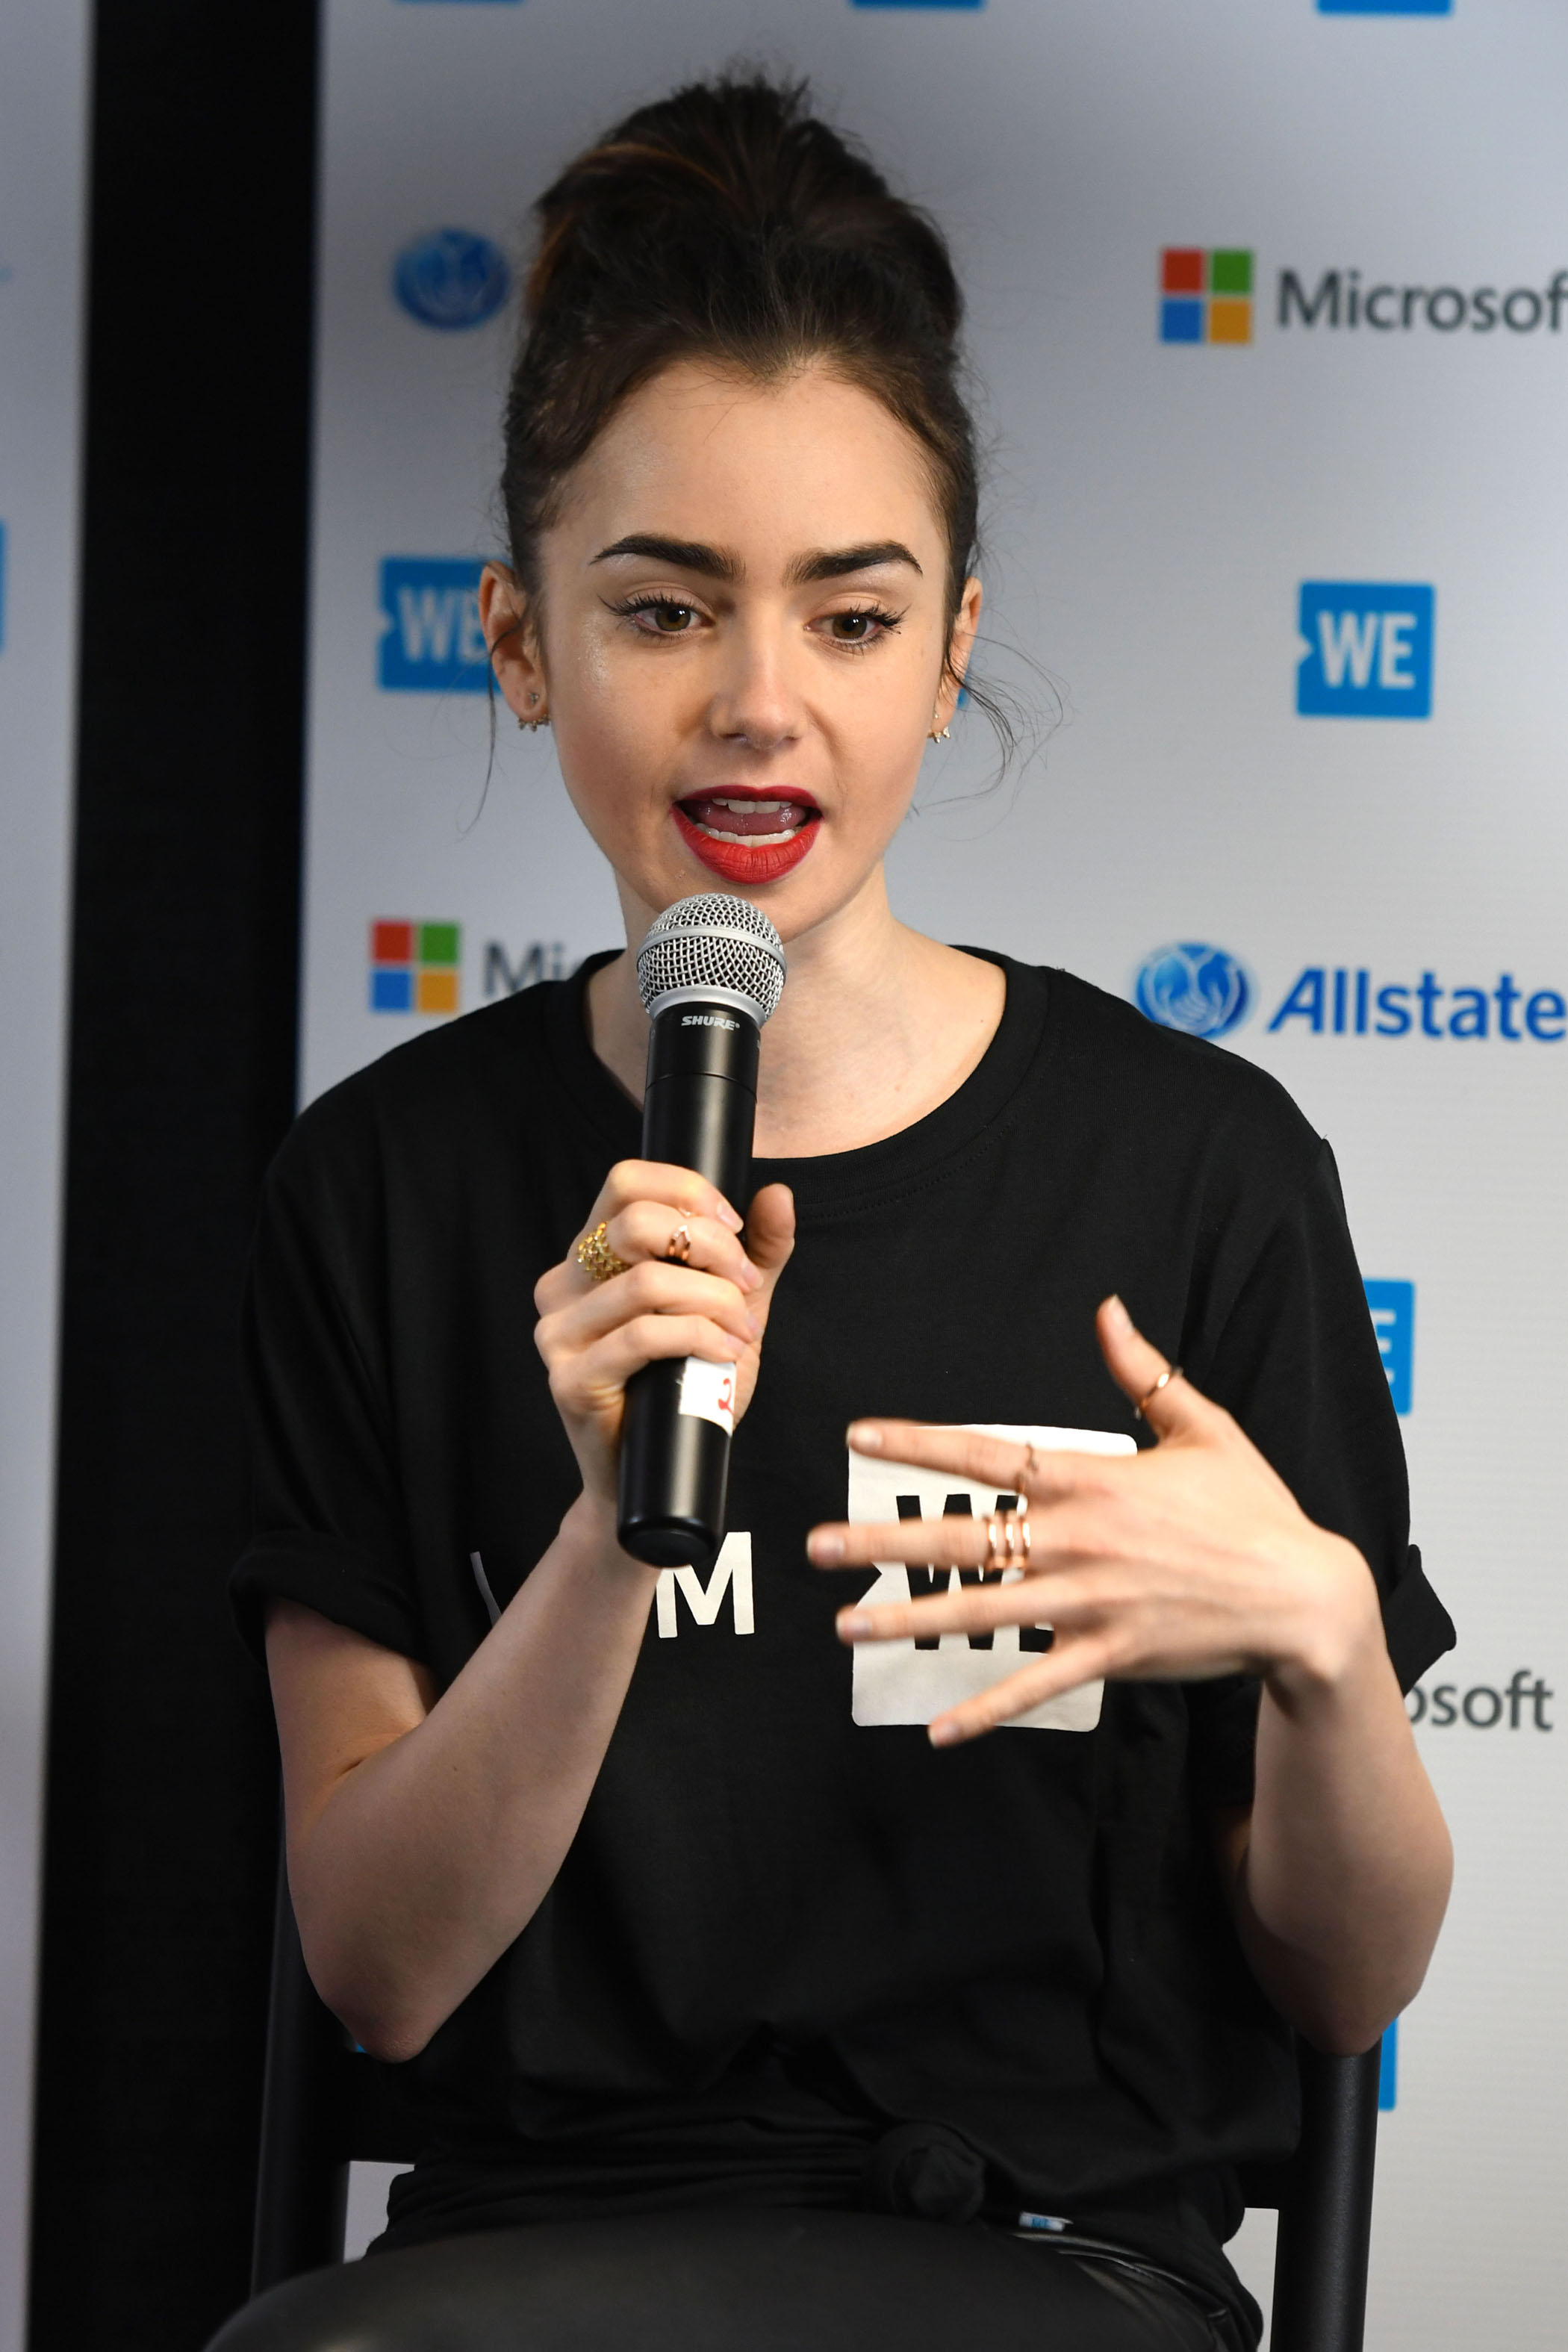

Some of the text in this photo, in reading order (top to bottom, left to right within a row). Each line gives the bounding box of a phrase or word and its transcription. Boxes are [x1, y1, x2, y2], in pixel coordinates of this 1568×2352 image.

[1317, 609, 1417, 689] WE
[483, 939, 581, 998] Mi
[1266, 965, 1567, 1041] Allstate
